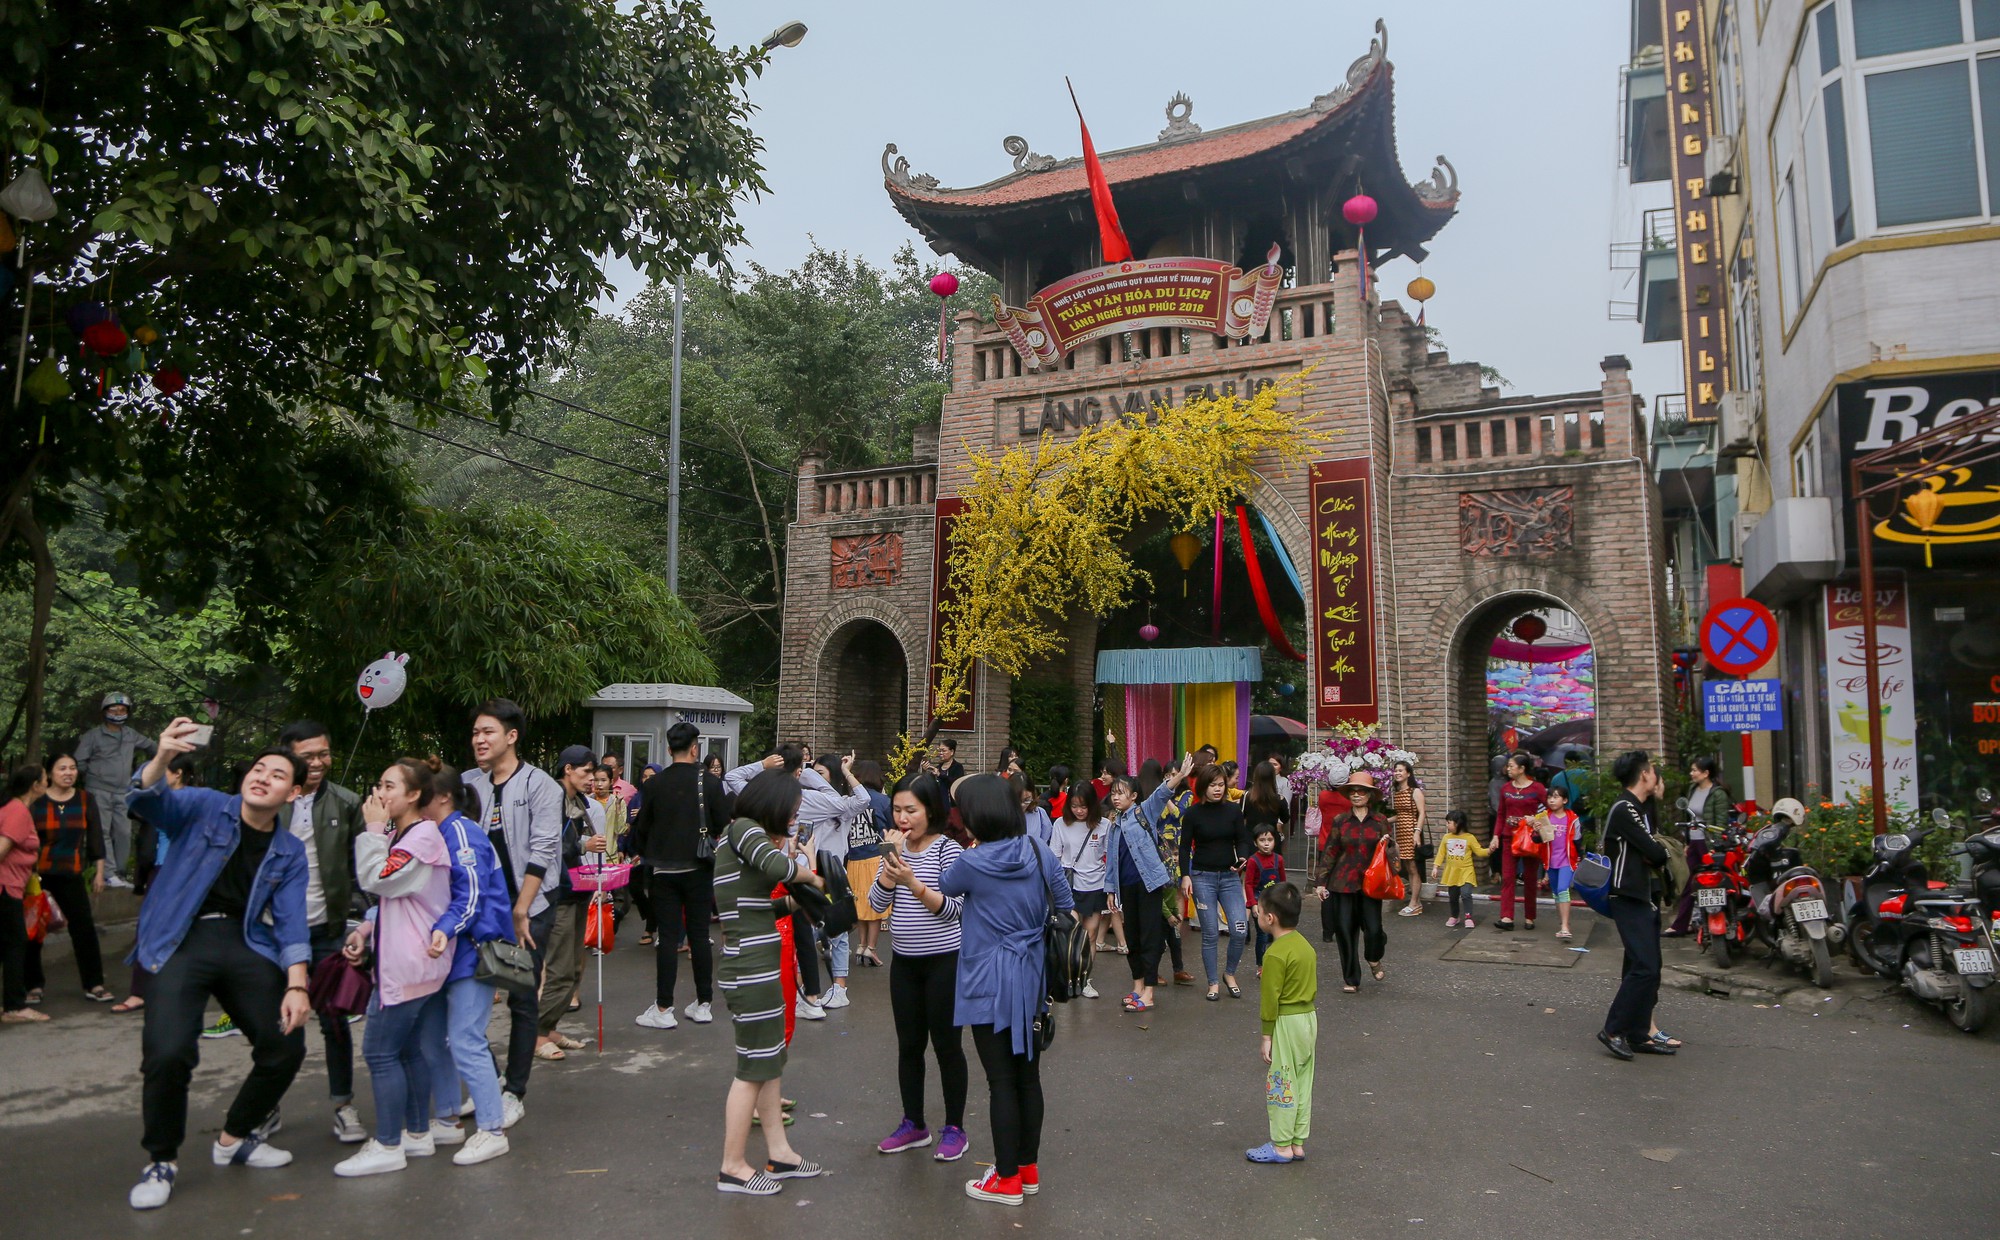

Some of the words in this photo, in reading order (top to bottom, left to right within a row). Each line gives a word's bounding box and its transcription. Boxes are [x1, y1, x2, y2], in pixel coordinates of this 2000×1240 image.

[1180, 275, 1200, 283] THAM
[1058, 301, 1093, 321] TUẦN
[1094, 294, 1122, 308] VĂN
[1124, 288, 1153, 302] HÓA
[1156, 287, 1176, 298] DU
[1178, 287, 1212, 300] LỊCH
[1069, 315, 1096, 331] LÀNG
[1124, 303, 1146, 316] VẠN
[1149, 300, 1177, 312] PHÚC
[1179, 302, 1205, 313] 2018
[1017, 398, 1103, 436] LÀNG
[1854, 386, 2000, 451] Re
[1834, 587, 1898, 606] Rey
[1327, 629, 1355, 652] Tinh
[1330, 655, 1355, 681] Hoa
[1836, 675, 1905, 699] Cfé
